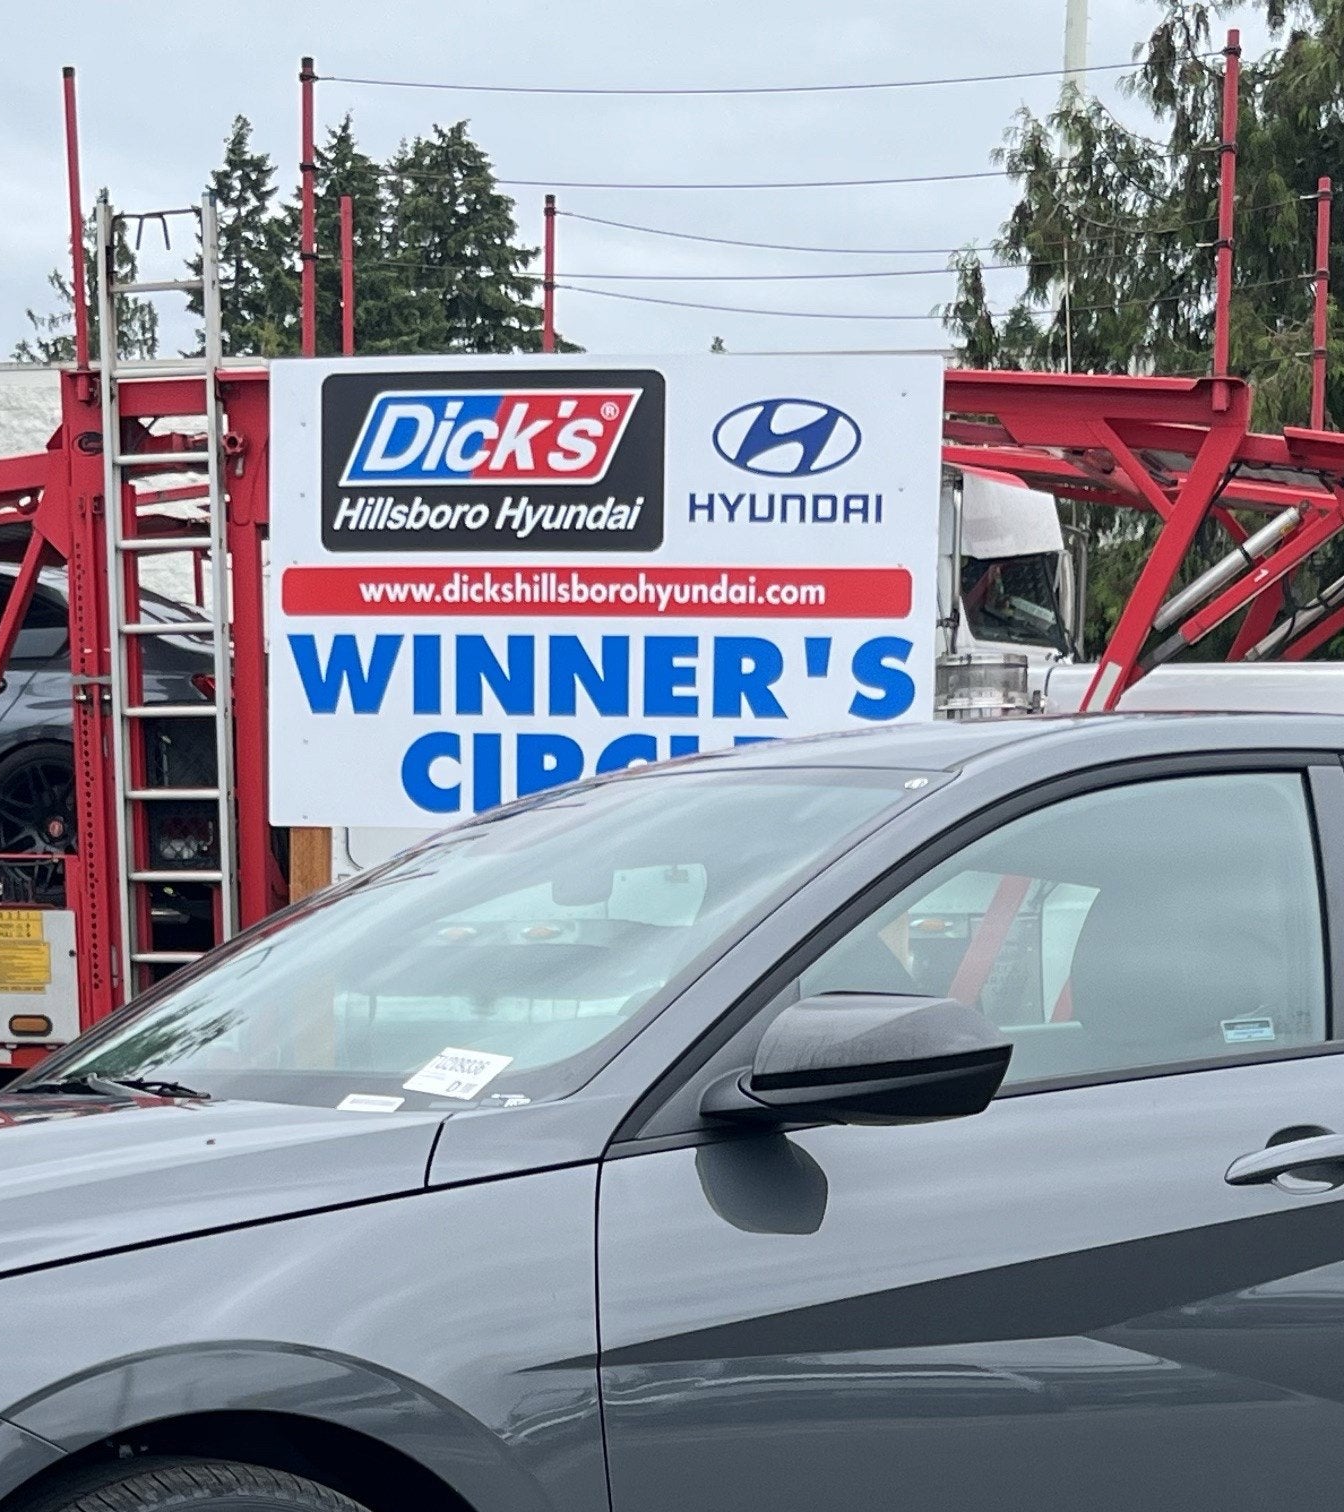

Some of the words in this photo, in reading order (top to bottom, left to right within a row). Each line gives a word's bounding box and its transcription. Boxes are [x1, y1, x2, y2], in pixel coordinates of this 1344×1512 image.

[363, 399, 604, 472] Dick's
[333, 496, 490, 531] Hillsboro
[494, 496, 645, 538] Hyundai
[689, 493, 883, 523] HYUNDAI
[359, 571, 827, 613] www.dickshillsborohyundai.com
[287, 634, 916, 720] WINNER'S
[401, 731, 784, 814] CIR
